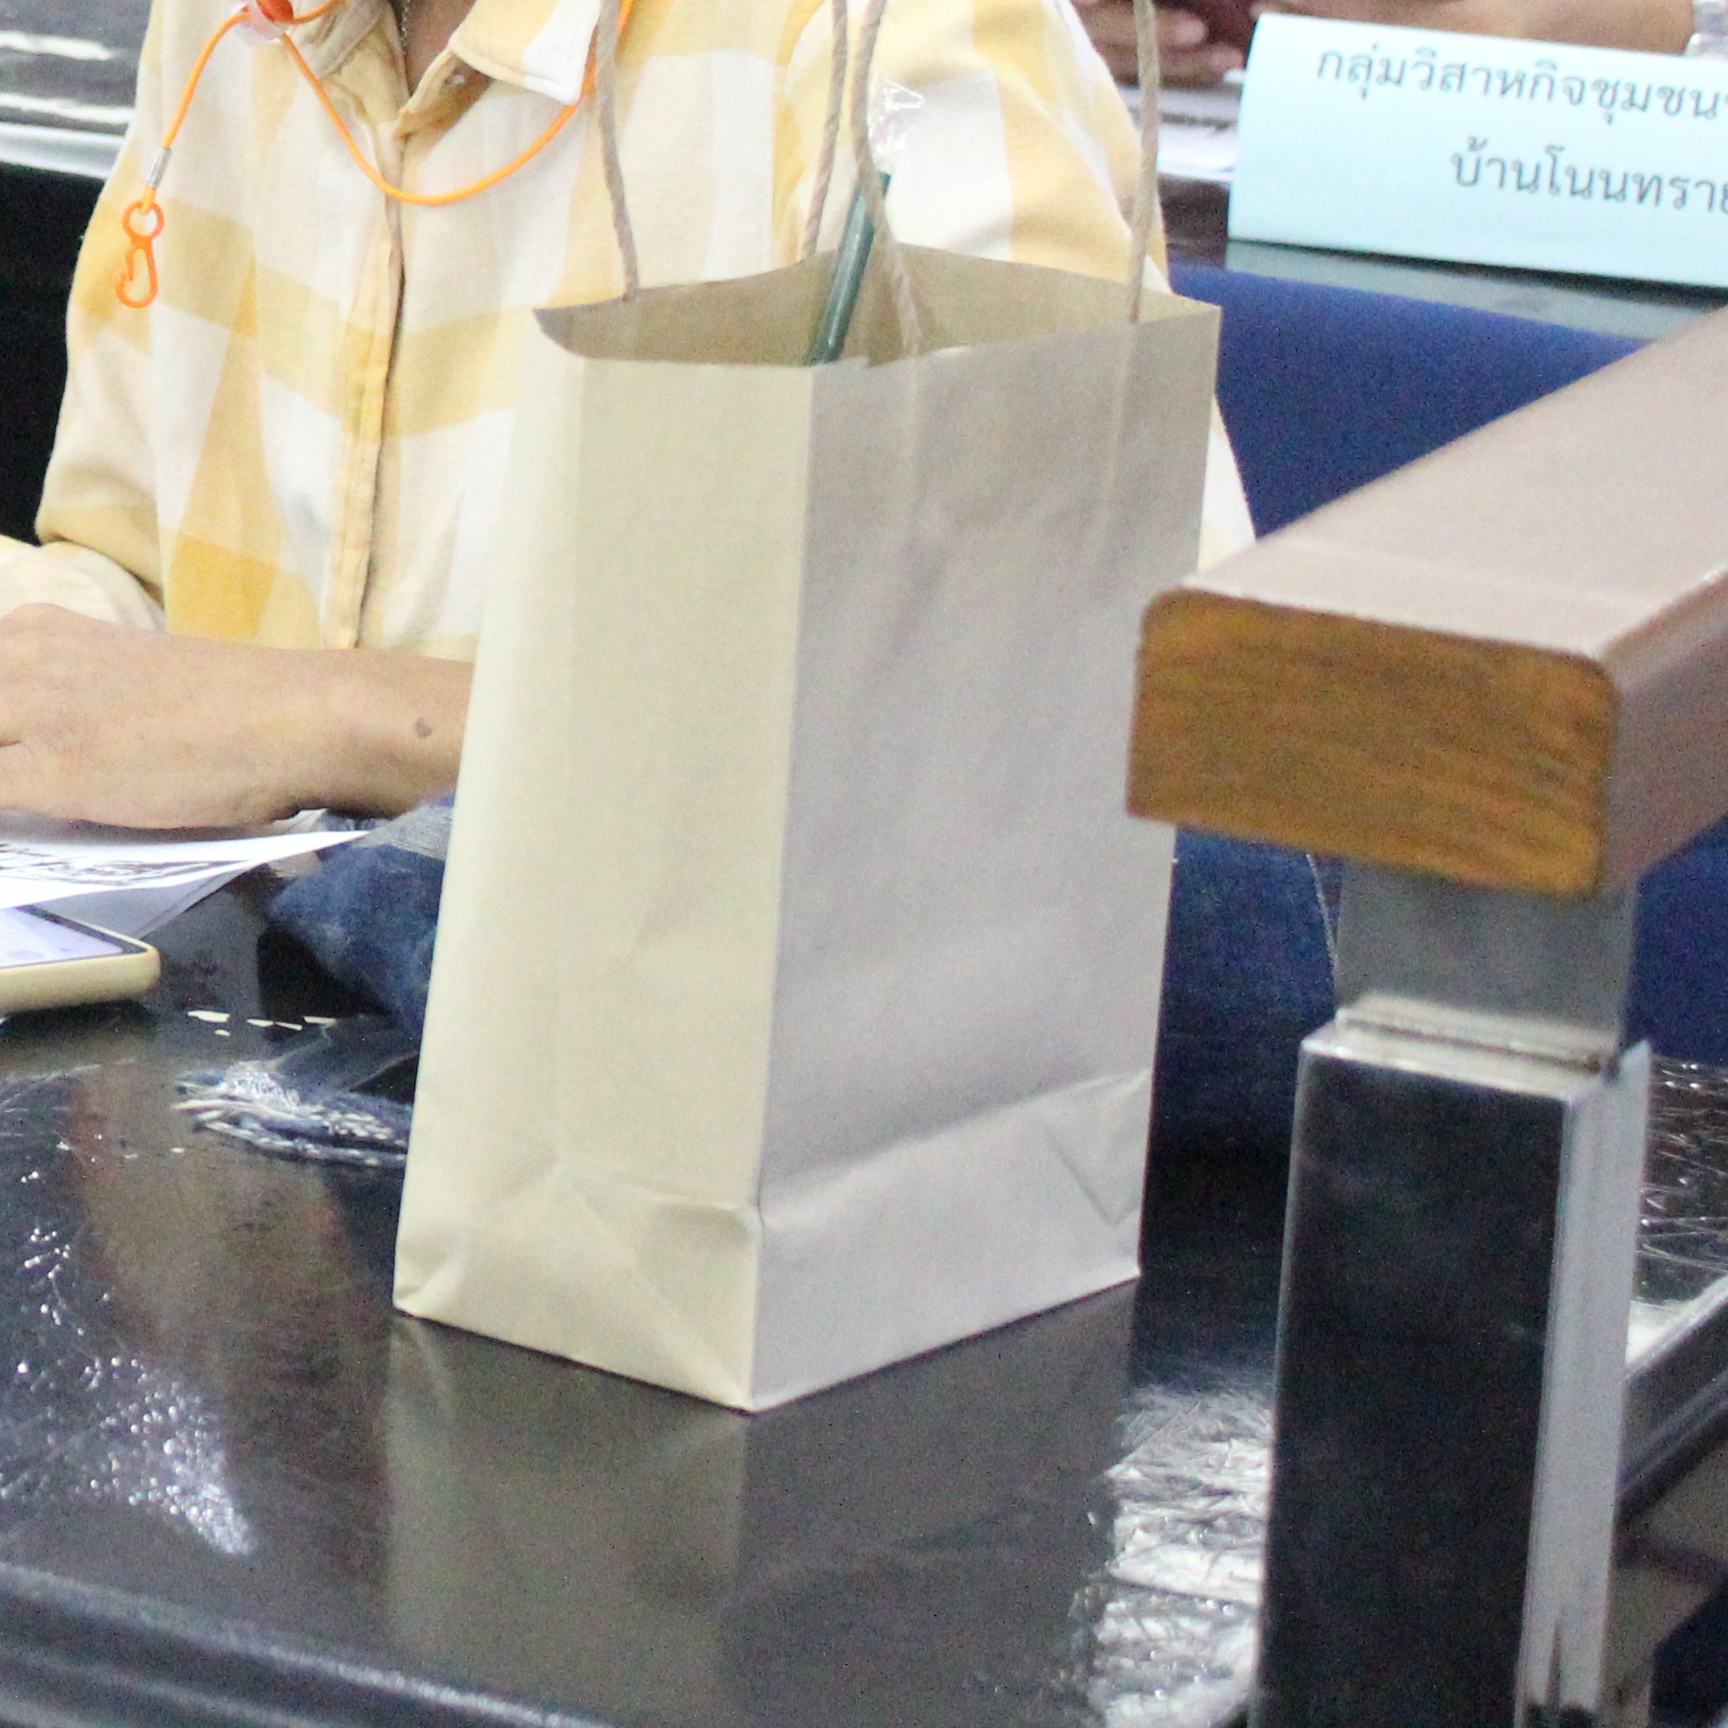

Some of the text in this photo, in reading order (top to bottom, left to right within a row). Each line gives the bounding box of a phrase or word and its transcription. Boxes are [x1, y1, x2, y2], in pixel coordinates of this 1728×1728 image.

[1316, 43, 1728, 125] กลุ่มวิสาหกิจชุมชน
